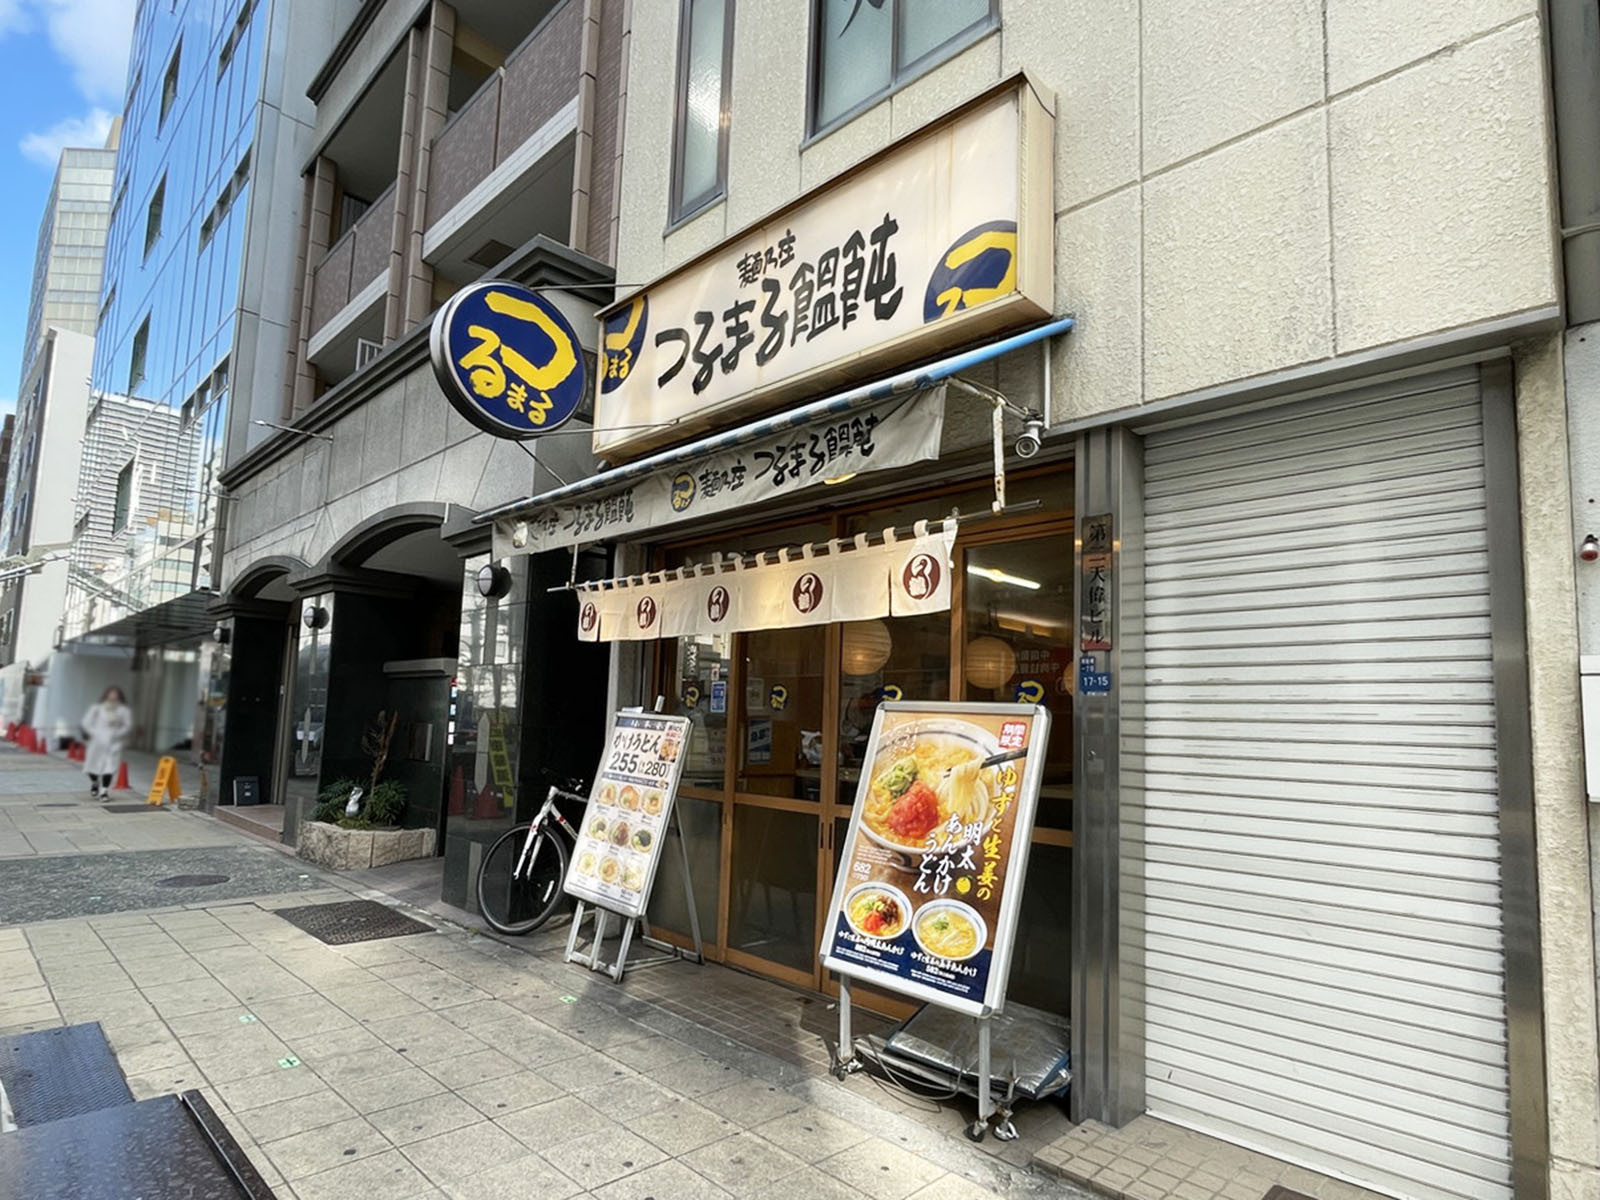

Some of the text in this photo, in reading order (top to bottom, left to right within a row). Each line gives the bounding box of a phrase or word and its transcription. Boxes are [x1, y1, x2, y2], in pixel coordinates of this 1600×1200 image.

[655, 212, 903, 395] つるまる饂飩
[1083, 676, 1109, 686] 17-15
[913, 834, 937, 894] うどん
[933, 813, 962, 895] あんかけ
[957, 821, 984, 870] 明太
[976, 767, 1018, 901] ゆずと生姜の
